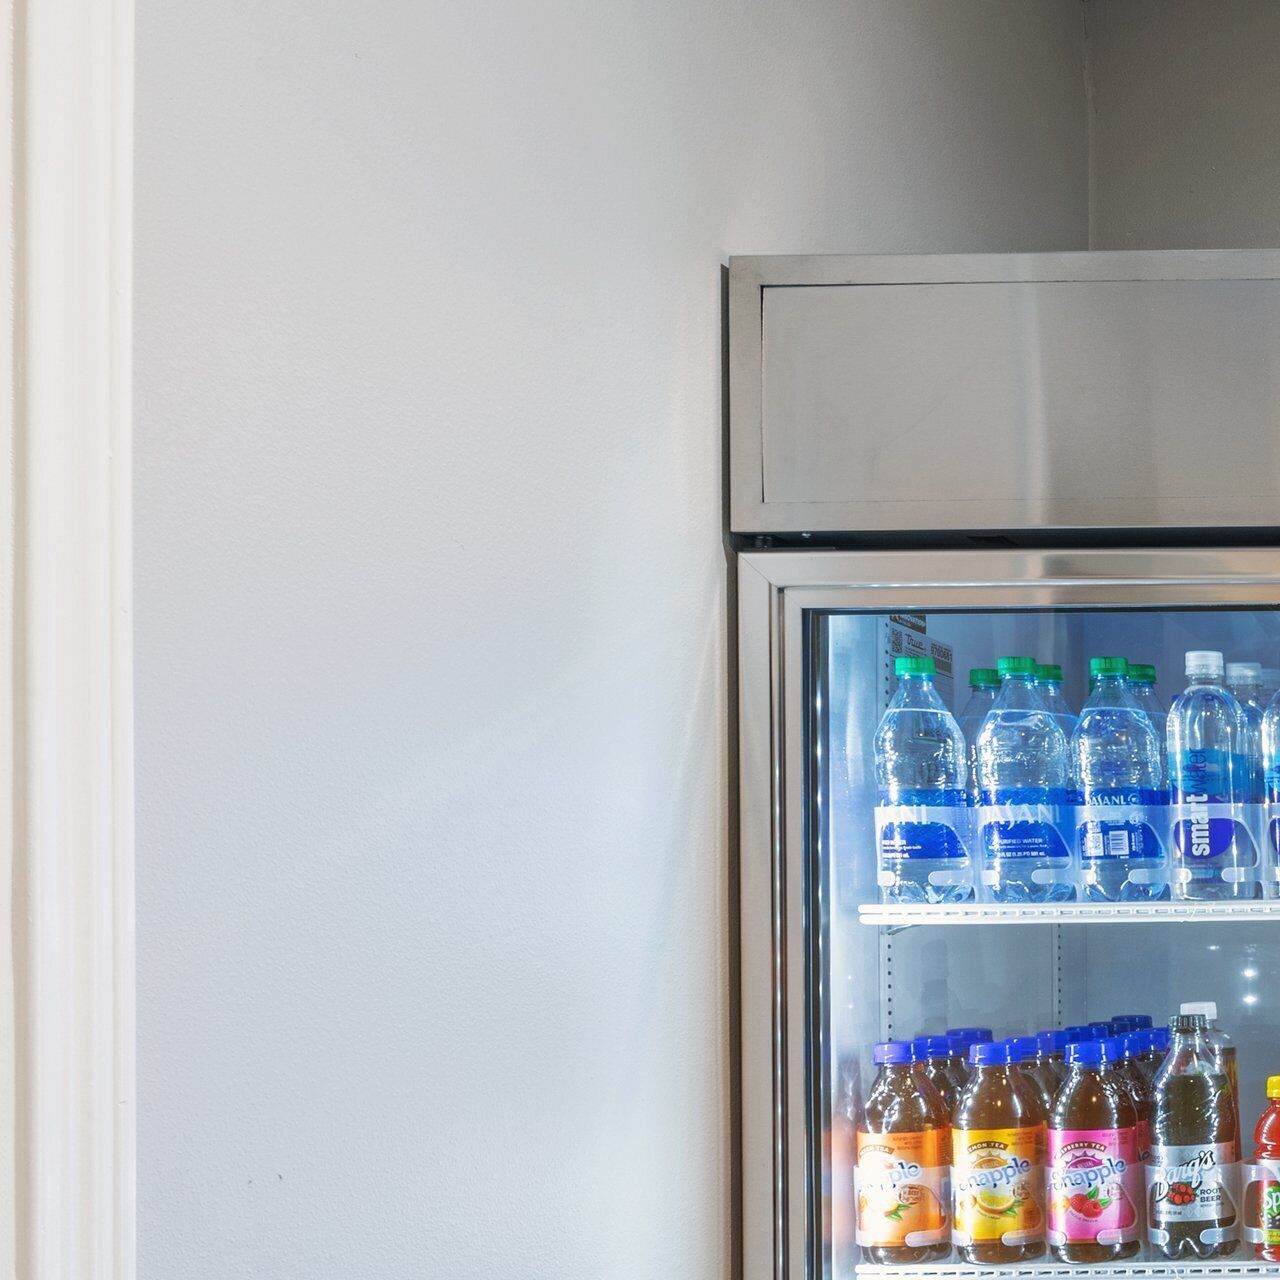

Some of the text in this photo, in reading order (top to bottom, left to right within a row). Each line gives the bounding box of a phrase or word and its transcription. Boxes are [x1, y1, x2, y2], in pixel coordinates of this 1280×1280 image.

[1186, 793, 1211, 857] smart
[990, 1142, 1006, 1150] TEA
[1200, 1188, 1222, 1196] ROOT
[1200, 1195, 1222, 1203] BEER
